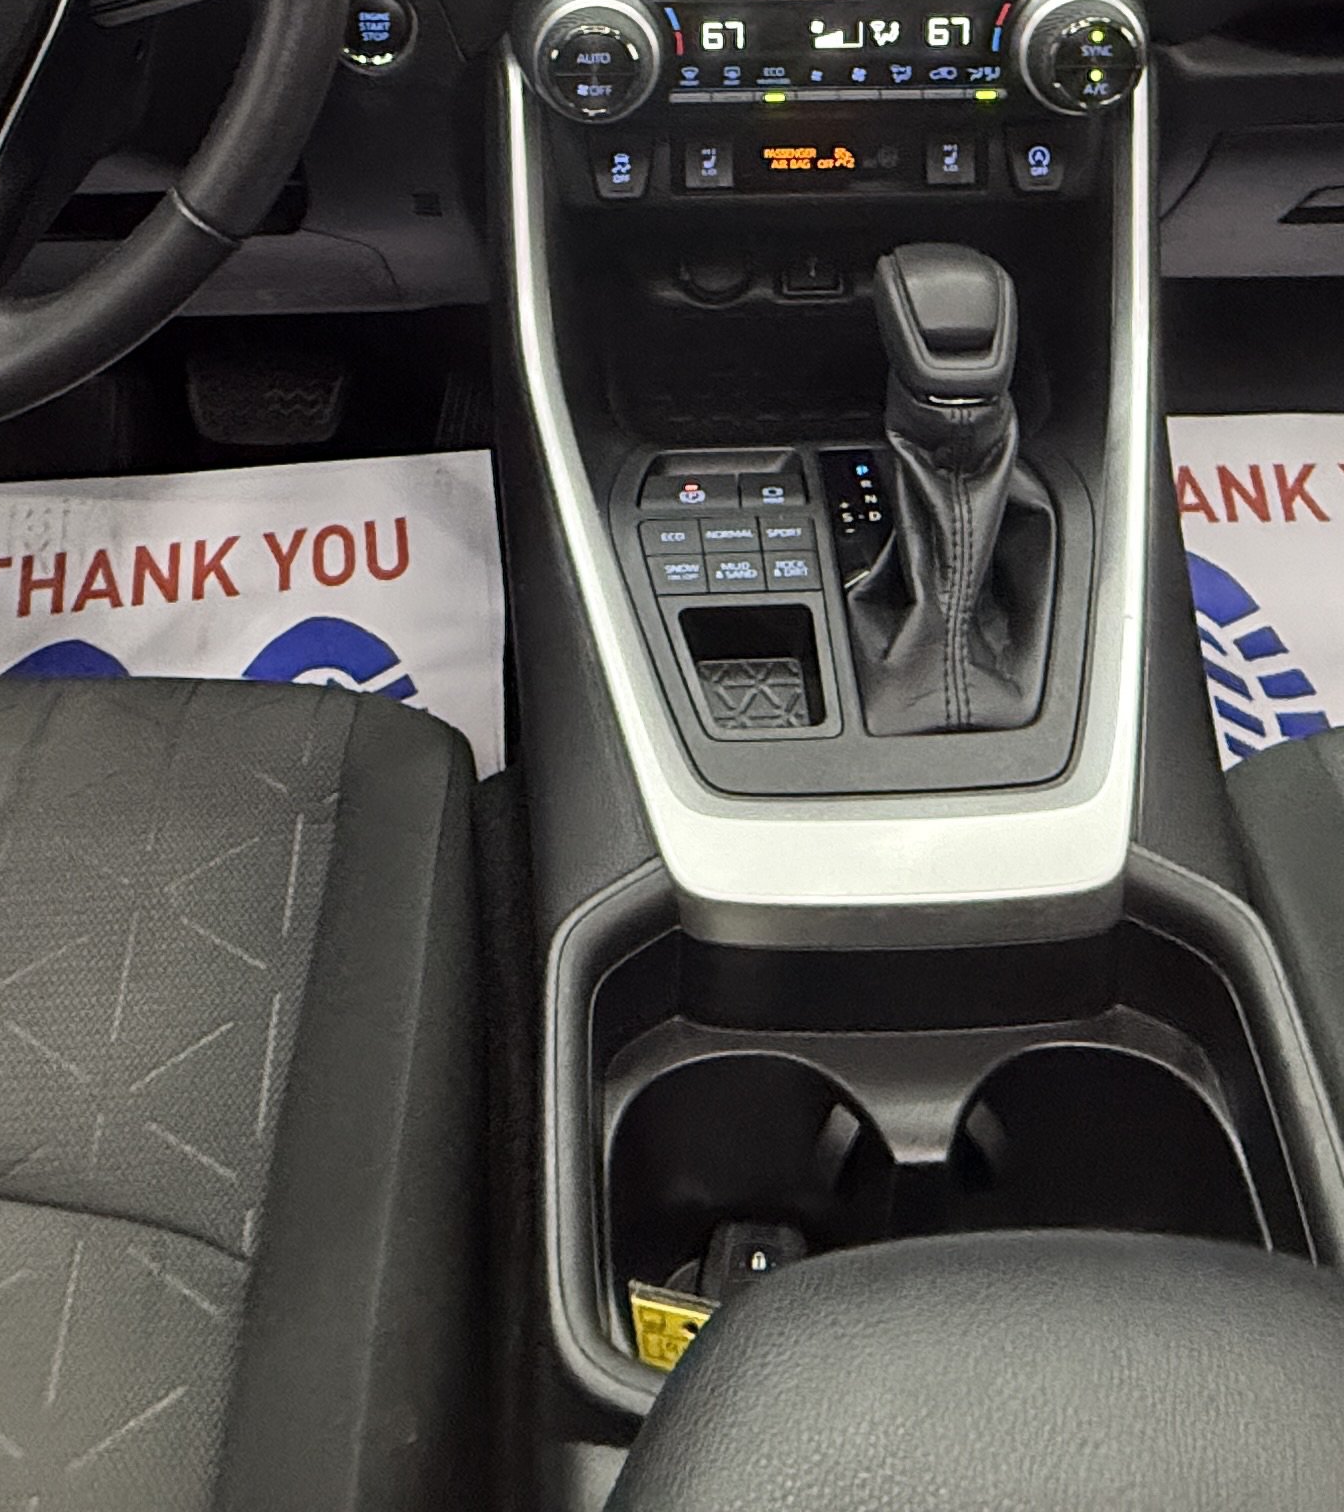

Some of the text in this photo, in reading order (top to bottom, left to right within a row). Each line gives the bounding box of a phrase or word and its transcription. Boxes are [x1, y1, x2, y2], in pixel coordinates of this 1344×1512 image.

[359, 11, 390, 21] ENGINE
[358, 21, 391, 31] START
[928, 16, 971, 47] 67
[361, 31, 390, 41] STOP
[701, 21, 745, 50] 67
[1081, 45, 1112, 57] SYNC
[576, 53, 611, 65] AUTO
[763, 67, 785, 77] ECO
[589, 85, 613, 96] OFF
[1082, 83, 1109, 95] A/C
[763, 148, 817, 158] PASSENGER
[771, 160, 834, 169] AIR BAG OFF
[1030, 166, 1049, 177] OFF
[612, 174, 631, 184] OFF
[1175, 462, 1331, 523] ANK
[864, 494, 878, 504] N
[842, 512, 854, 523] S
[868, 510, 882, 522] D
[660, 532, 685, 542] ECO
[706, 529, 754, 539] NORMAL
[766, 527, 802, 538] SPORT
[263, 516, 410, 592] YOU
[664, 563, 701, 574] SNOW
[720, 561, 750, 571] MUD
[726, 569, 758, 580] SAND
